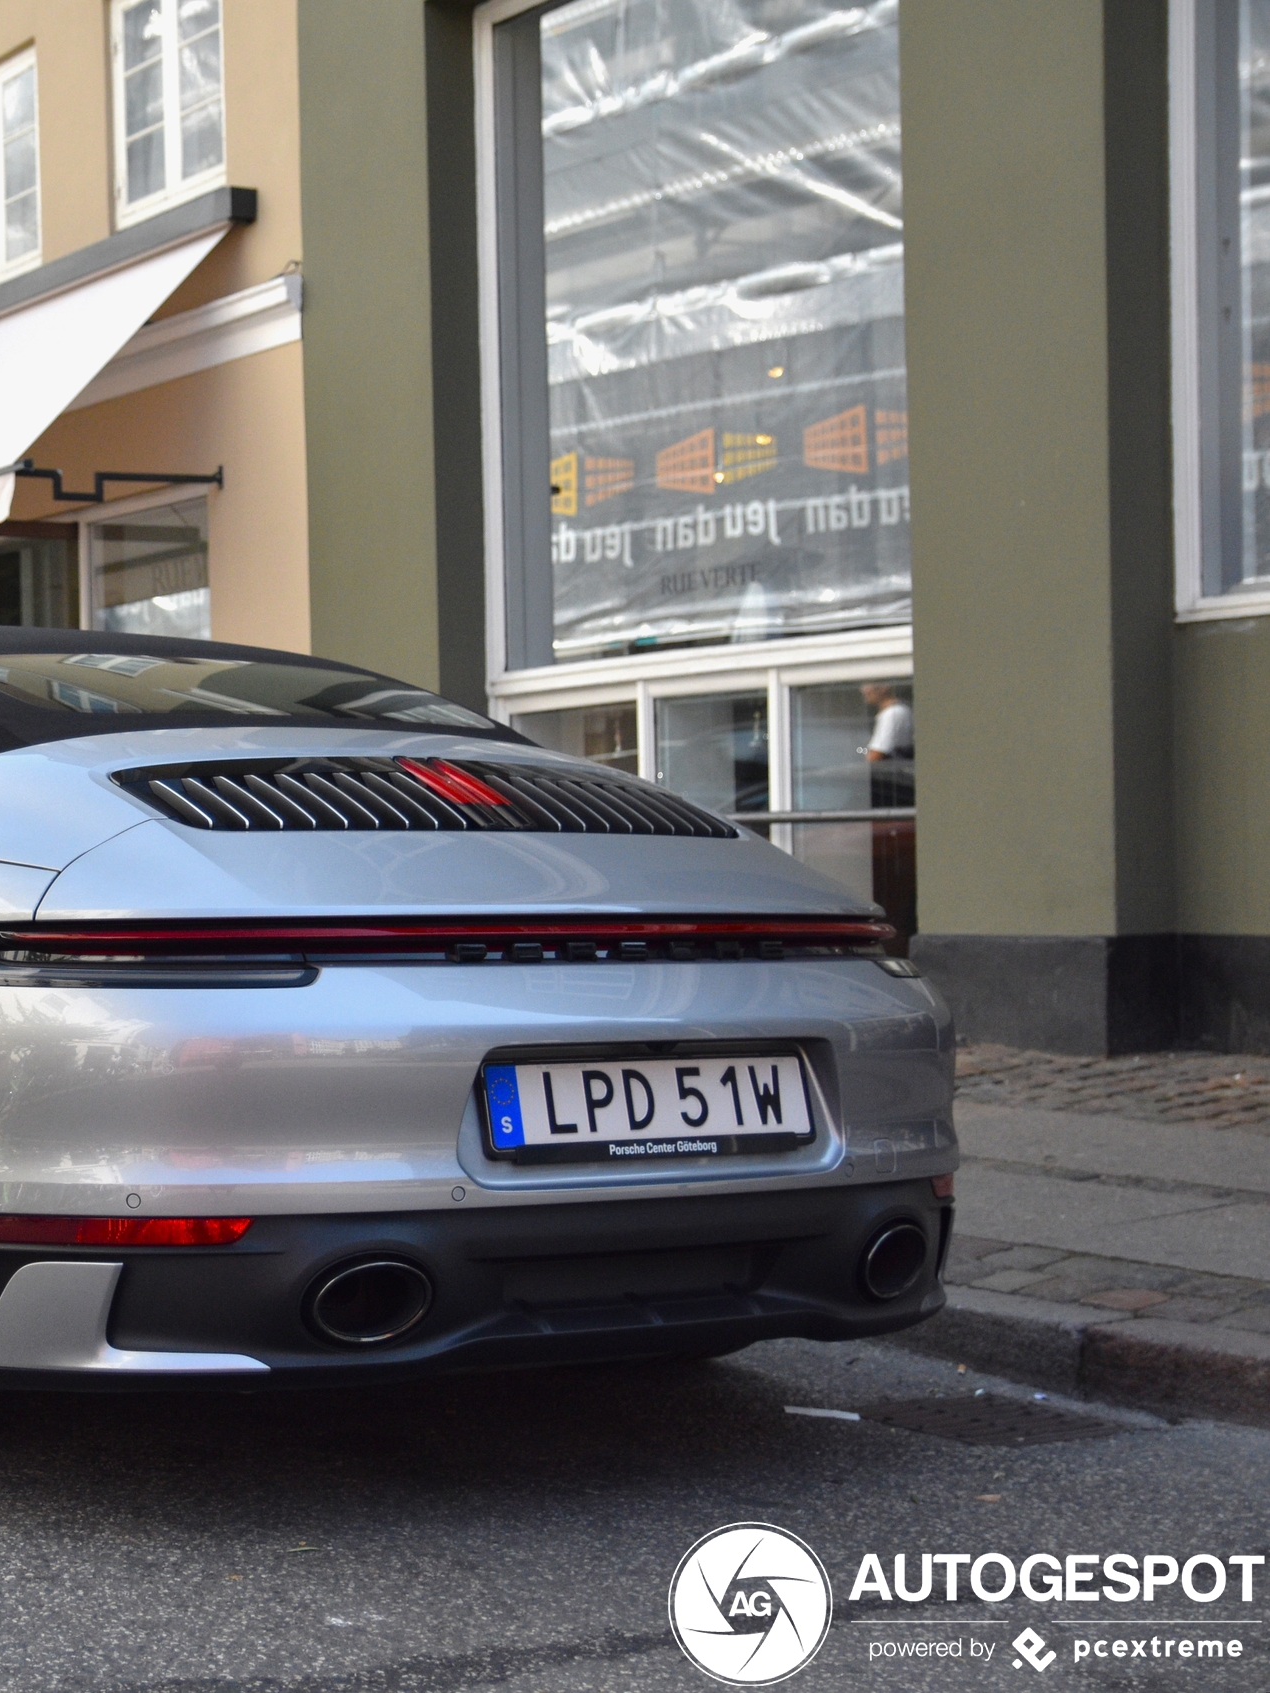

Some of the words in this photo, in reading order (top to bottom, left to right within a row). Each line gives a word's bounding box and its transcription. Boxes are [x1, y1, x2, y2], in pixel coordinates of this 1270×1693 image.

[660, 571, 698, 596] RUE
[542, 1069, 656, 1135] LPD
[674, 1064, 783, 1128] 51W
[500, 1116, 514, 1134] S
[609, 1143, 646, 1156] Porsche
[646, 1142, 676, 1154] Center
[676, 1140, 717, 1153] Göteborg
